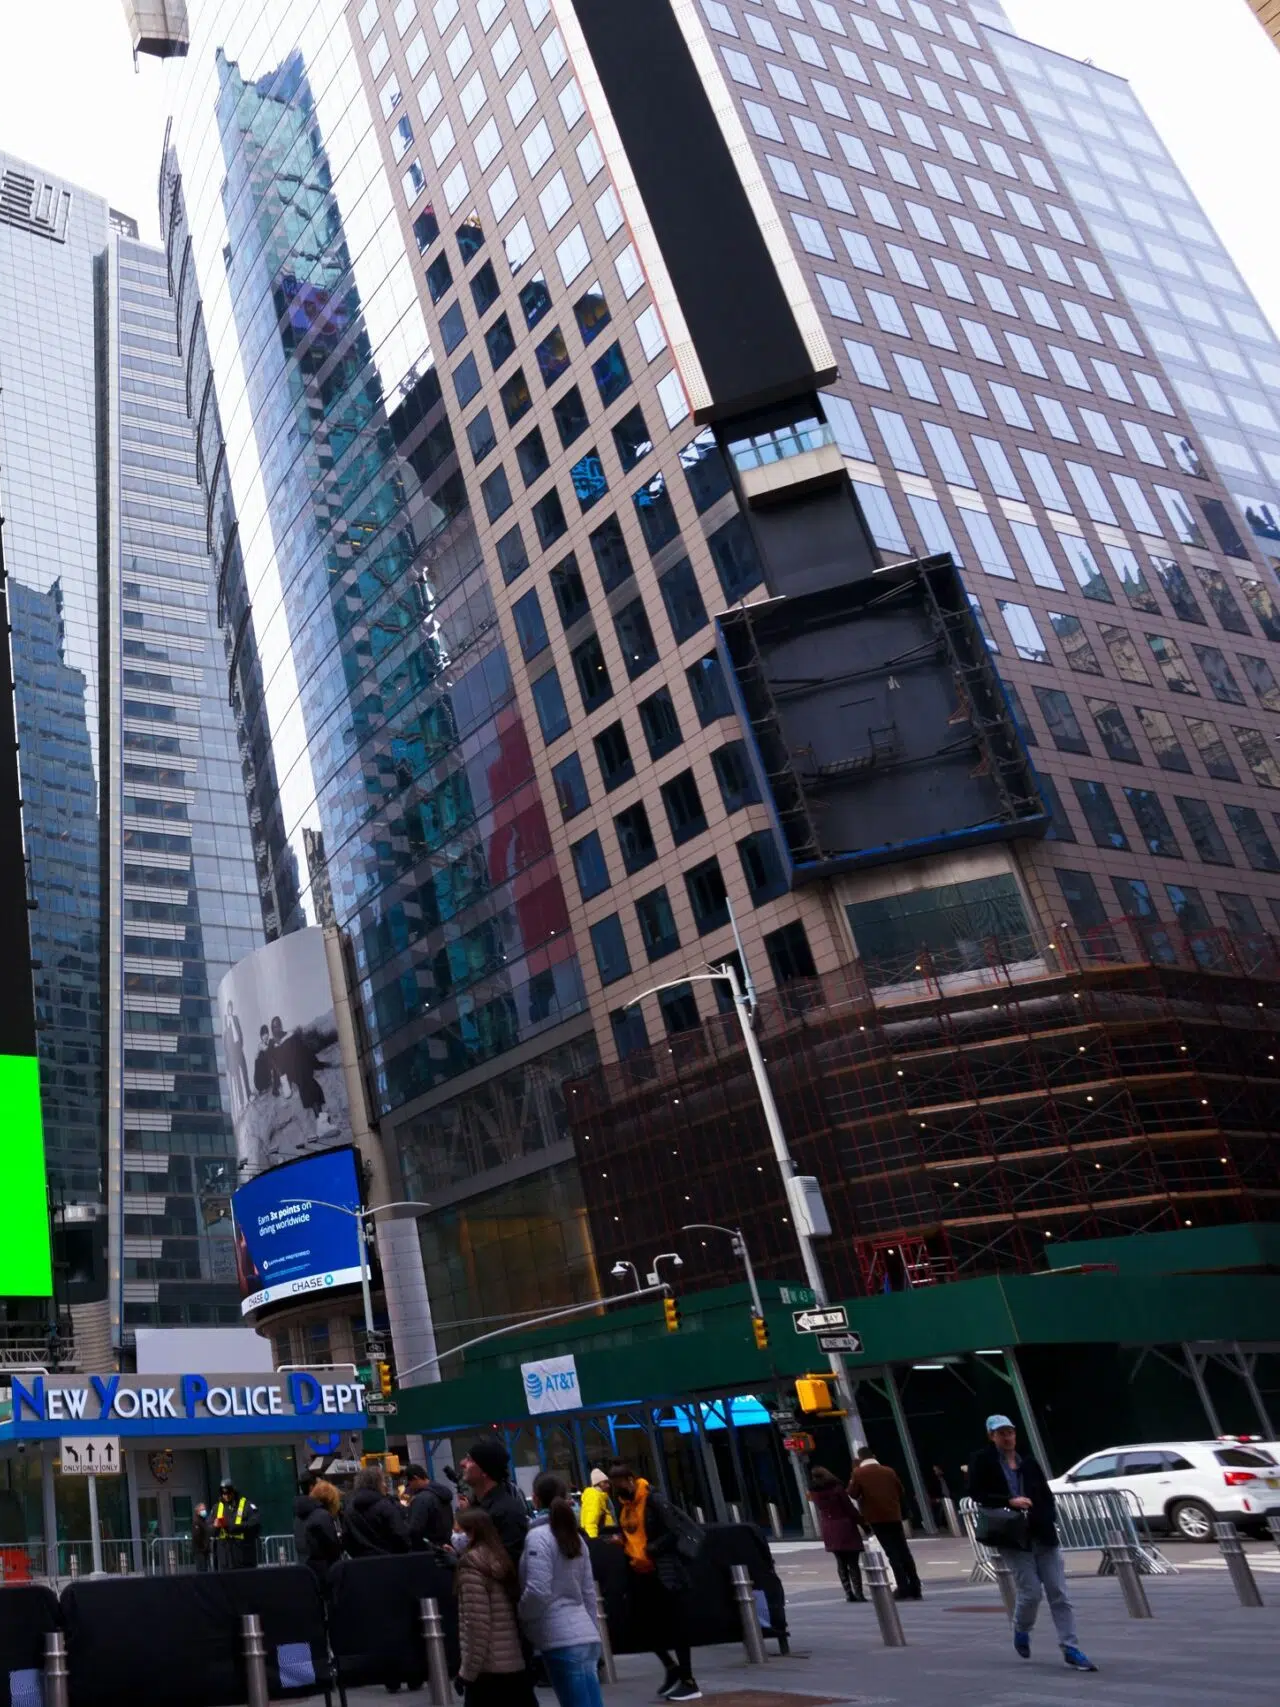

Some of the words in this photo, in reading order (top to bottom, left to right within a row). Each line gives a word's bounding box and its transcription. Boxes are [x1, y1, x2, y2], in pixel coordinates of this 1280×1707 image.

[258, 1215, 269, 1226] Earn
[270, 1211, 278, 1221] 3x
[278, 1204, 301, 1221] points
[302, 1201, 312, 1211] on
[259, 1224, 276, 1236] dining
[275, 1213, 310, 1230] worldwide
[292, 1277, 324, 1292] CHASE
[249, 1295, 263, 1308] CHASE
[802, 1317, 817, 1326] ONE
[823, 1313, 840, 1323] WAY
[546, 1371, 575, 1392] AT&T
[64, 1464, 80, 1472] ONLY
[83, 1464, 99, 1472] ONLY
[101, 1464, 118, 1472] ONLY
